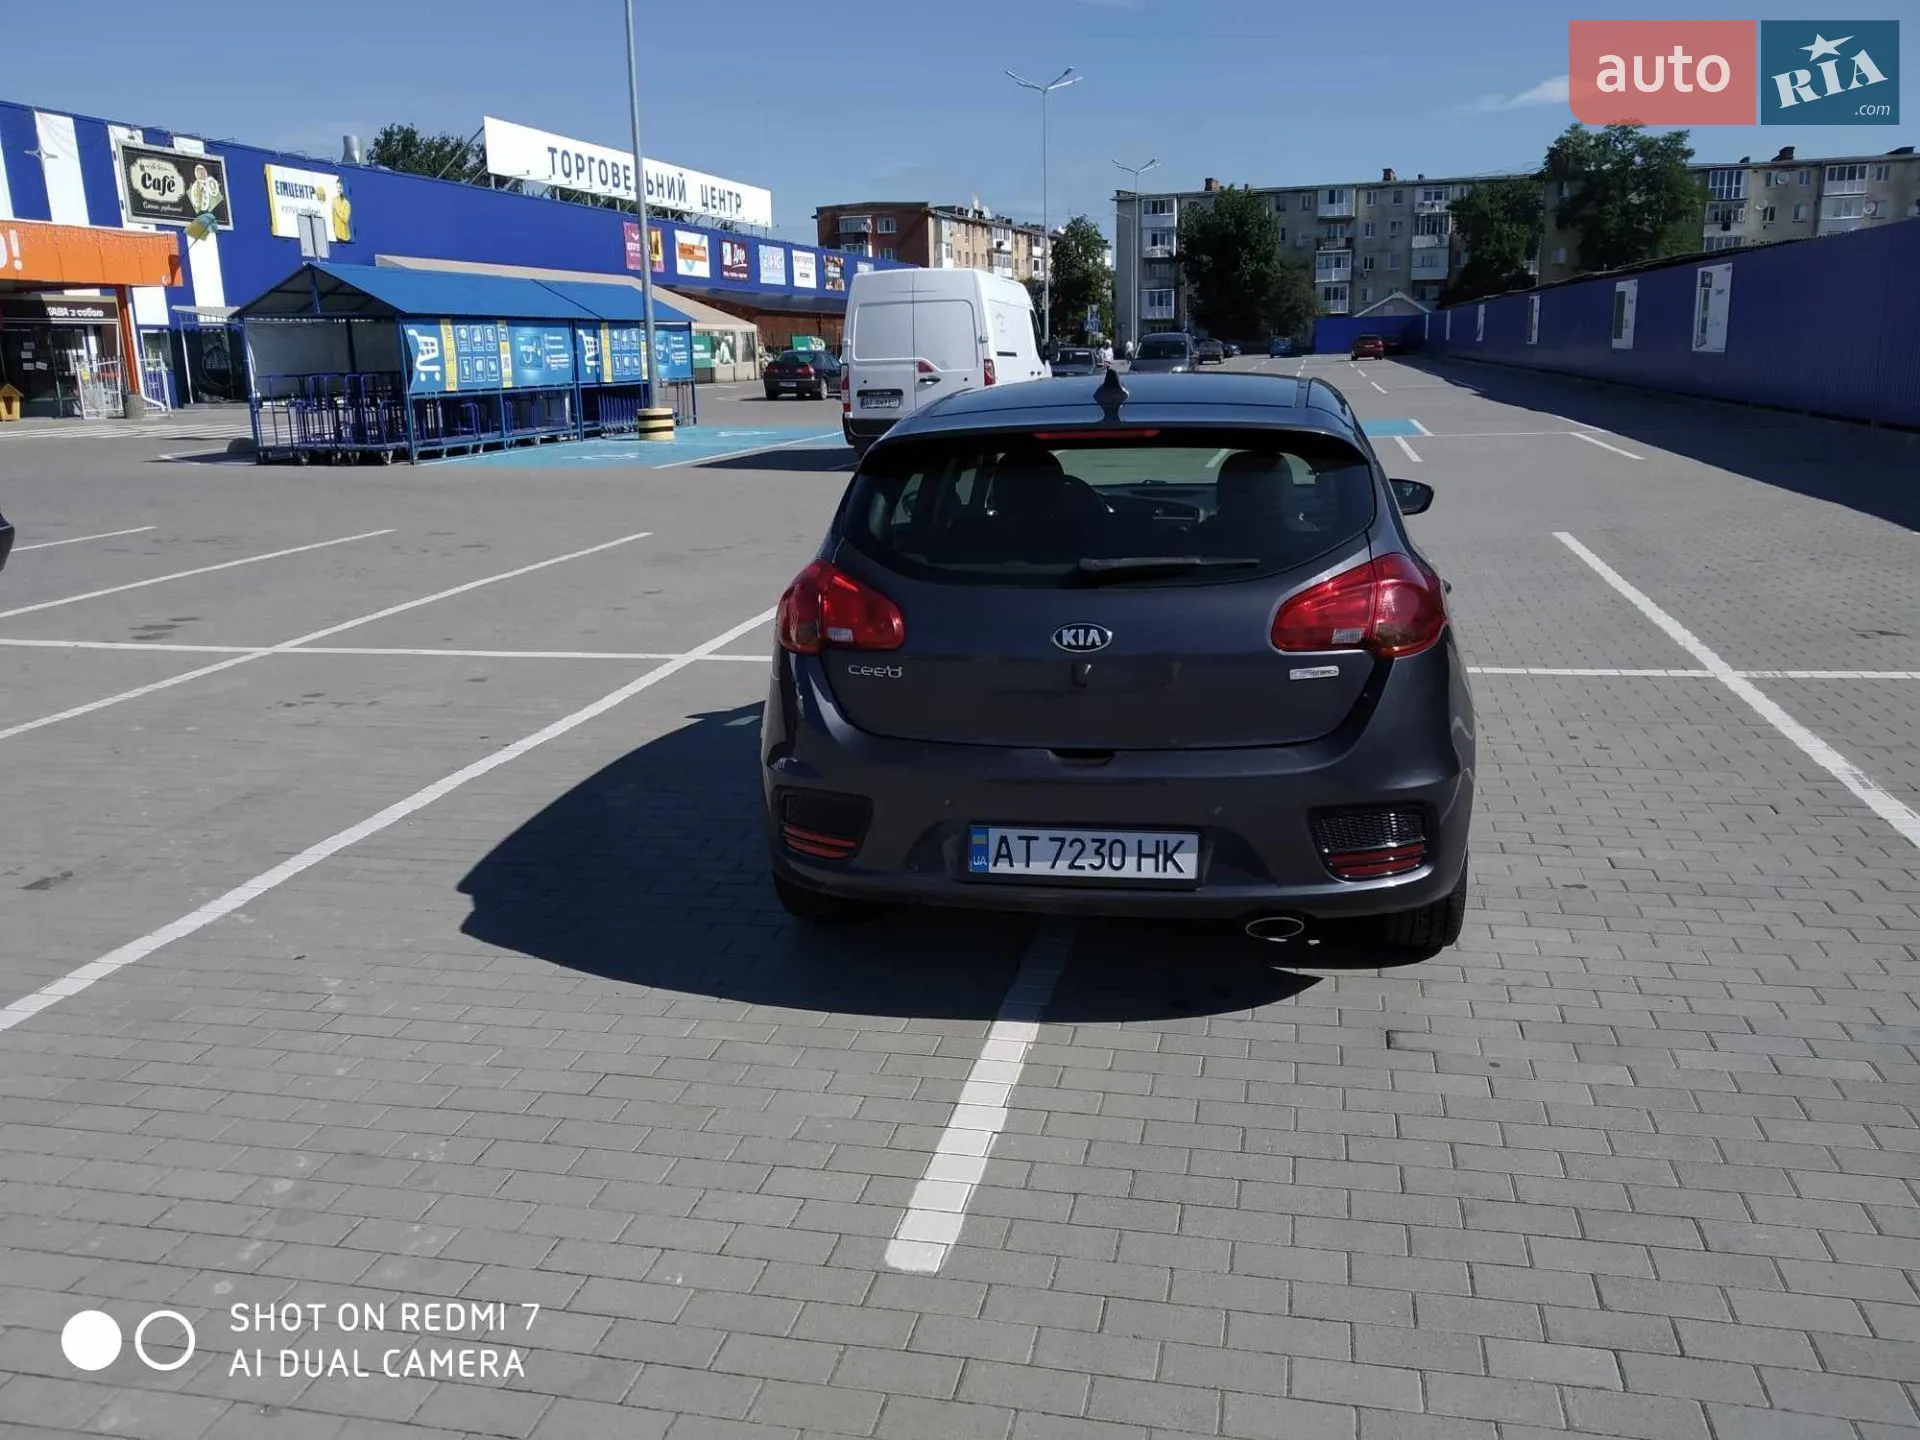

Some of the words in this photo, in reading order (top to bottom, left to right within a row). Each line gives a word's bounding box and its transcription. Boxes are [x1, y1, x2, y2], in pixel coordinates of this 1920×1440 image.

[141, 172, 176, 196] Café
[547, 146, 687, 203] ТОРГОВЕЬНИЙ
[700, 183, 742, 212] ЦЕНТР
[1062, 629, 1101, 646] KIA
[973, 857, 987, 866] UA
[992, 835, 1039, 868] AT
[1049, 836, 1126, 871] 7230
[1137, 839, 1185, 873] HK
